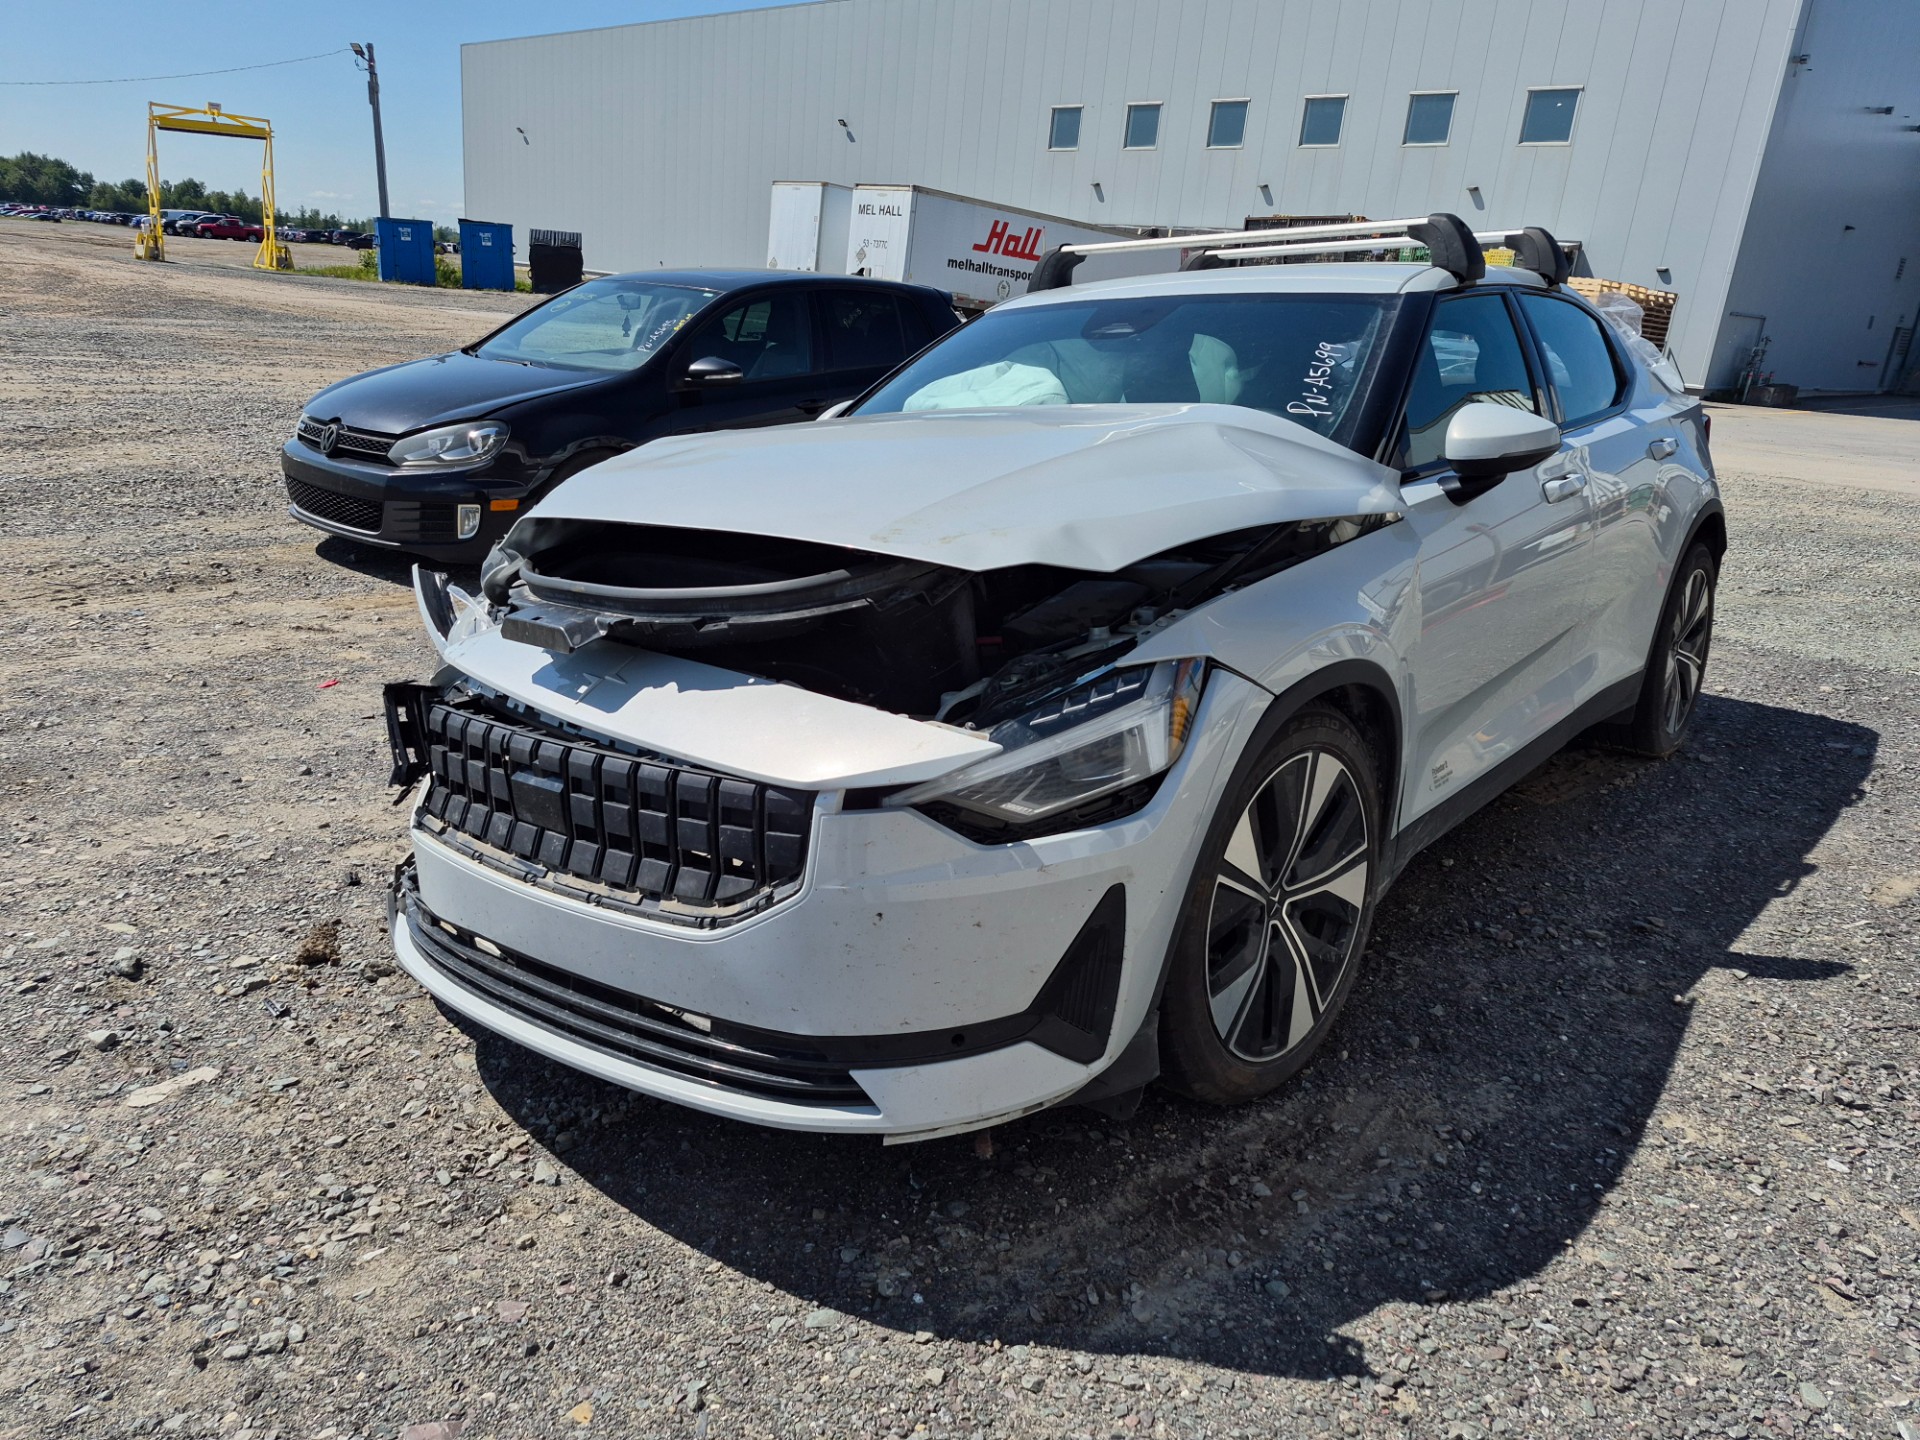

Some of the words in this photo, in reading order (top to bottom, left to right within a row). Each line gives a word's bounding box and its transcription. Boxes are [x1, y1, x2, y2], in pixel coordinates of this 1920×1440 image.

[858, 204, 876, 215] MEL
[879, 204, 902, 217] HALL
[972, 219, 1042, 262] Hall
[947, 258, 1033, 282] melhalltranspor
